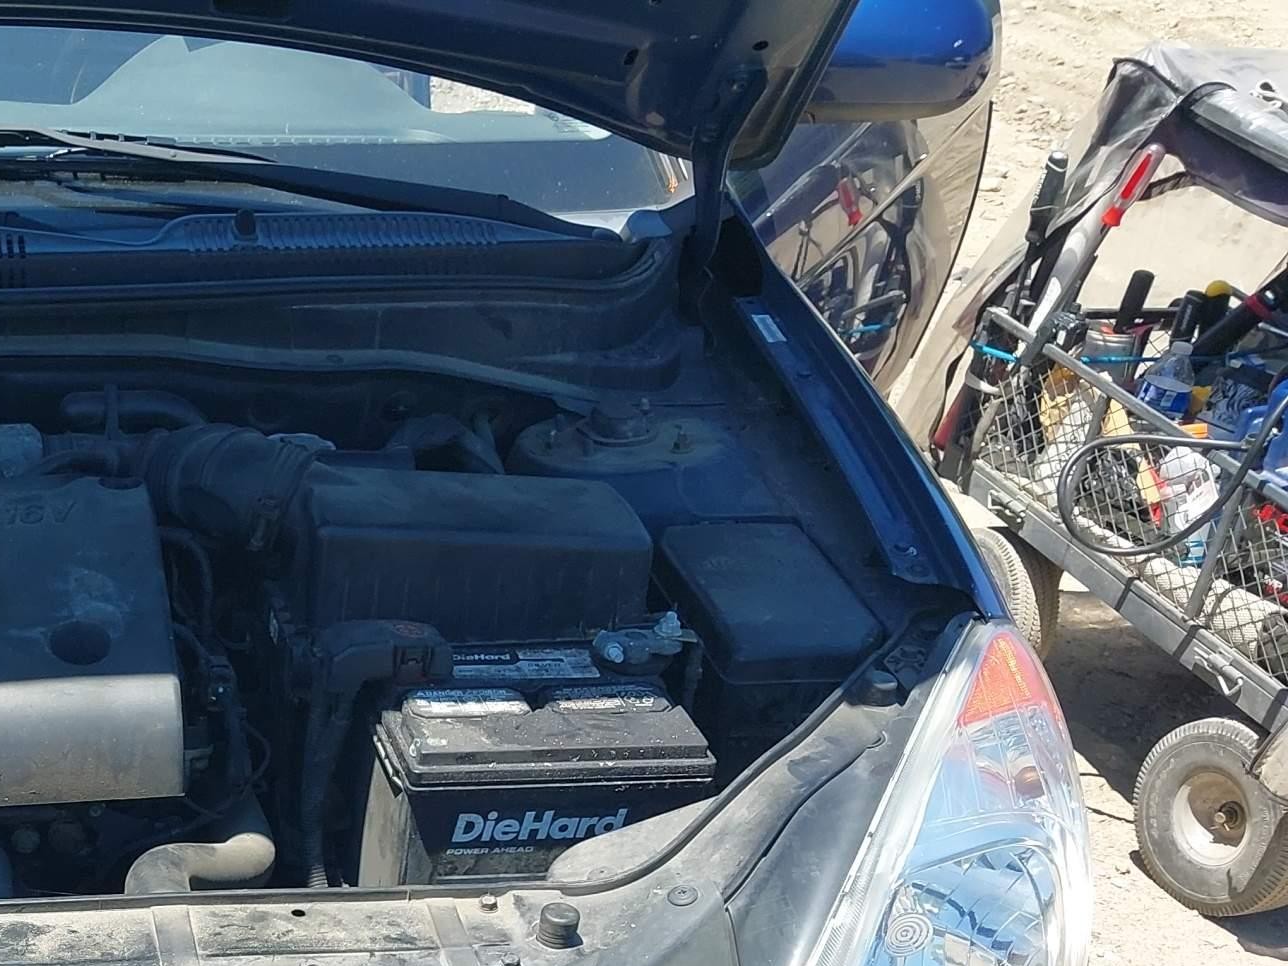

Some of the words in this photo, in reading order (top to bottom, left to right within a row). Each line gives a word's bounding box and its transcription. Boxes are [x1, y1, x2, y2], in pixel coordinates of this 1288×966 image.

[5, 500, 78, 526] 16V
[452, 652, 511, 661] DieHard
[451, 808, 629, 843] DieHard
[446, 847, 489, 856] POWER
